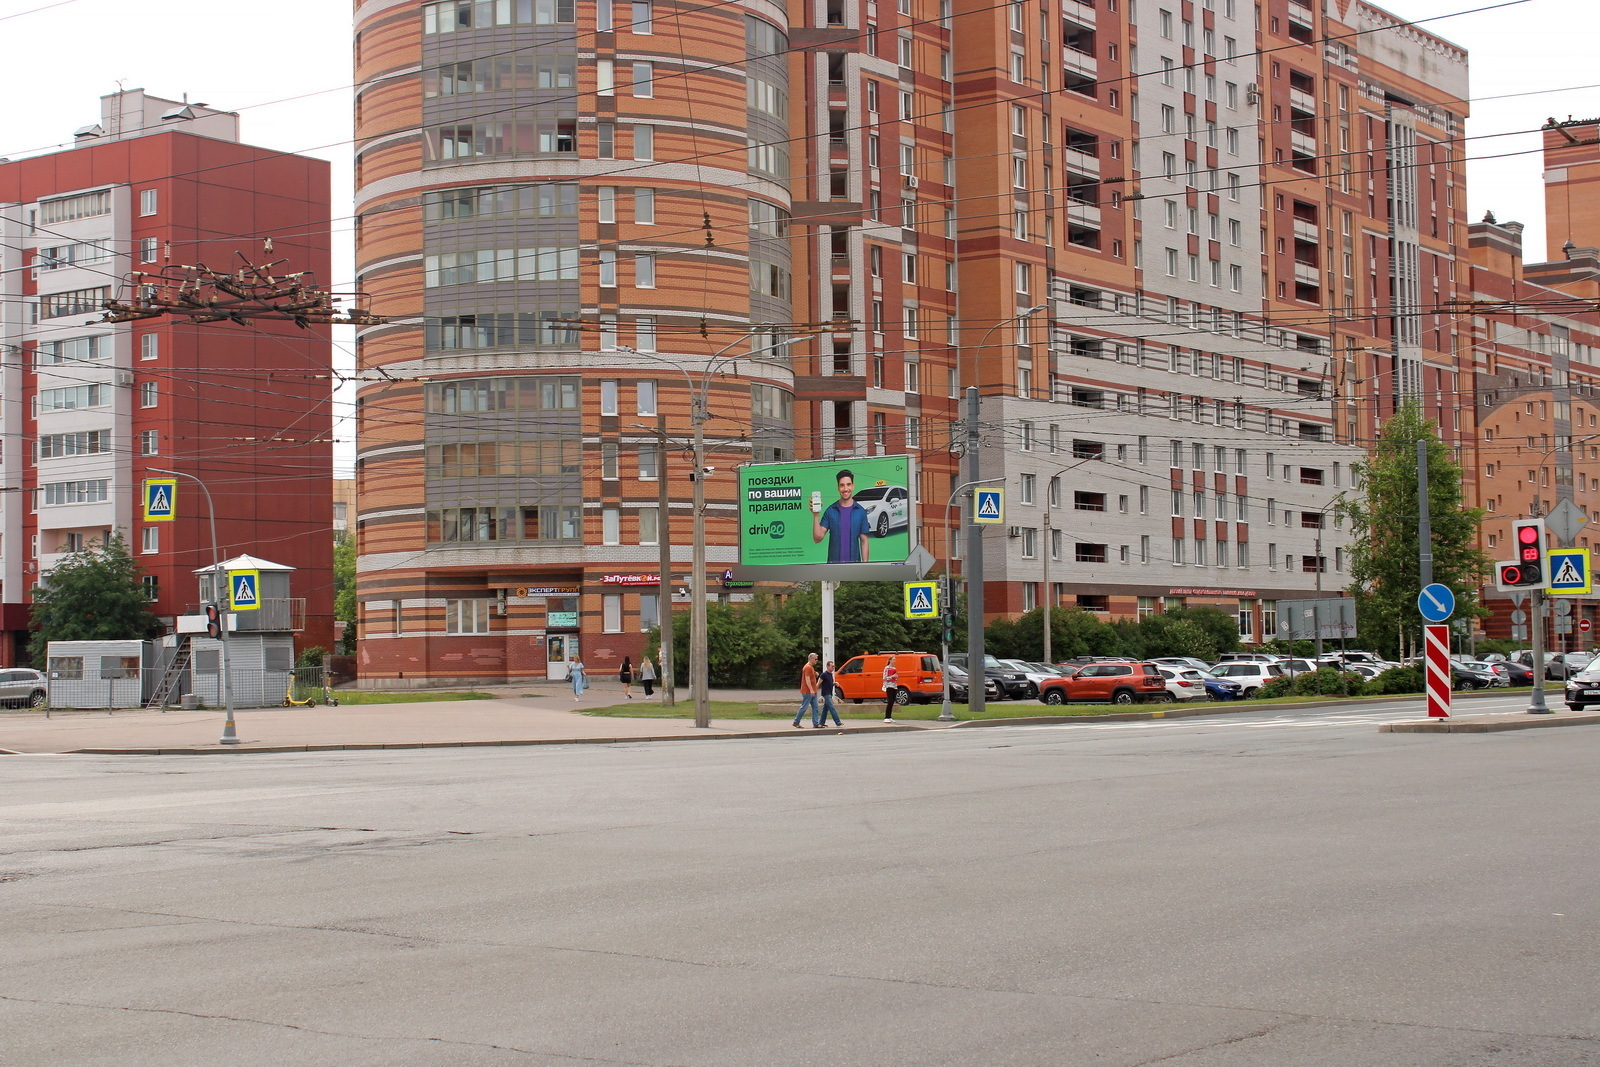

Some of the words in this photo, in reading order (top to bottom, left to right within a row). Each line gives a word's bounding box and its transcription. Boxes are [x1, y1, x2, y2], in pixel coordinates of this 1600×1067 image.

[748, 475, 794, 486] поездки
[748, 490, 762, 500] по
[764, 488, 801, 499] вашим
[748, 502, 802, 515] правилам
[748, 521, 785, 537] drivee
[1523, 548, 1538, 560] 69
